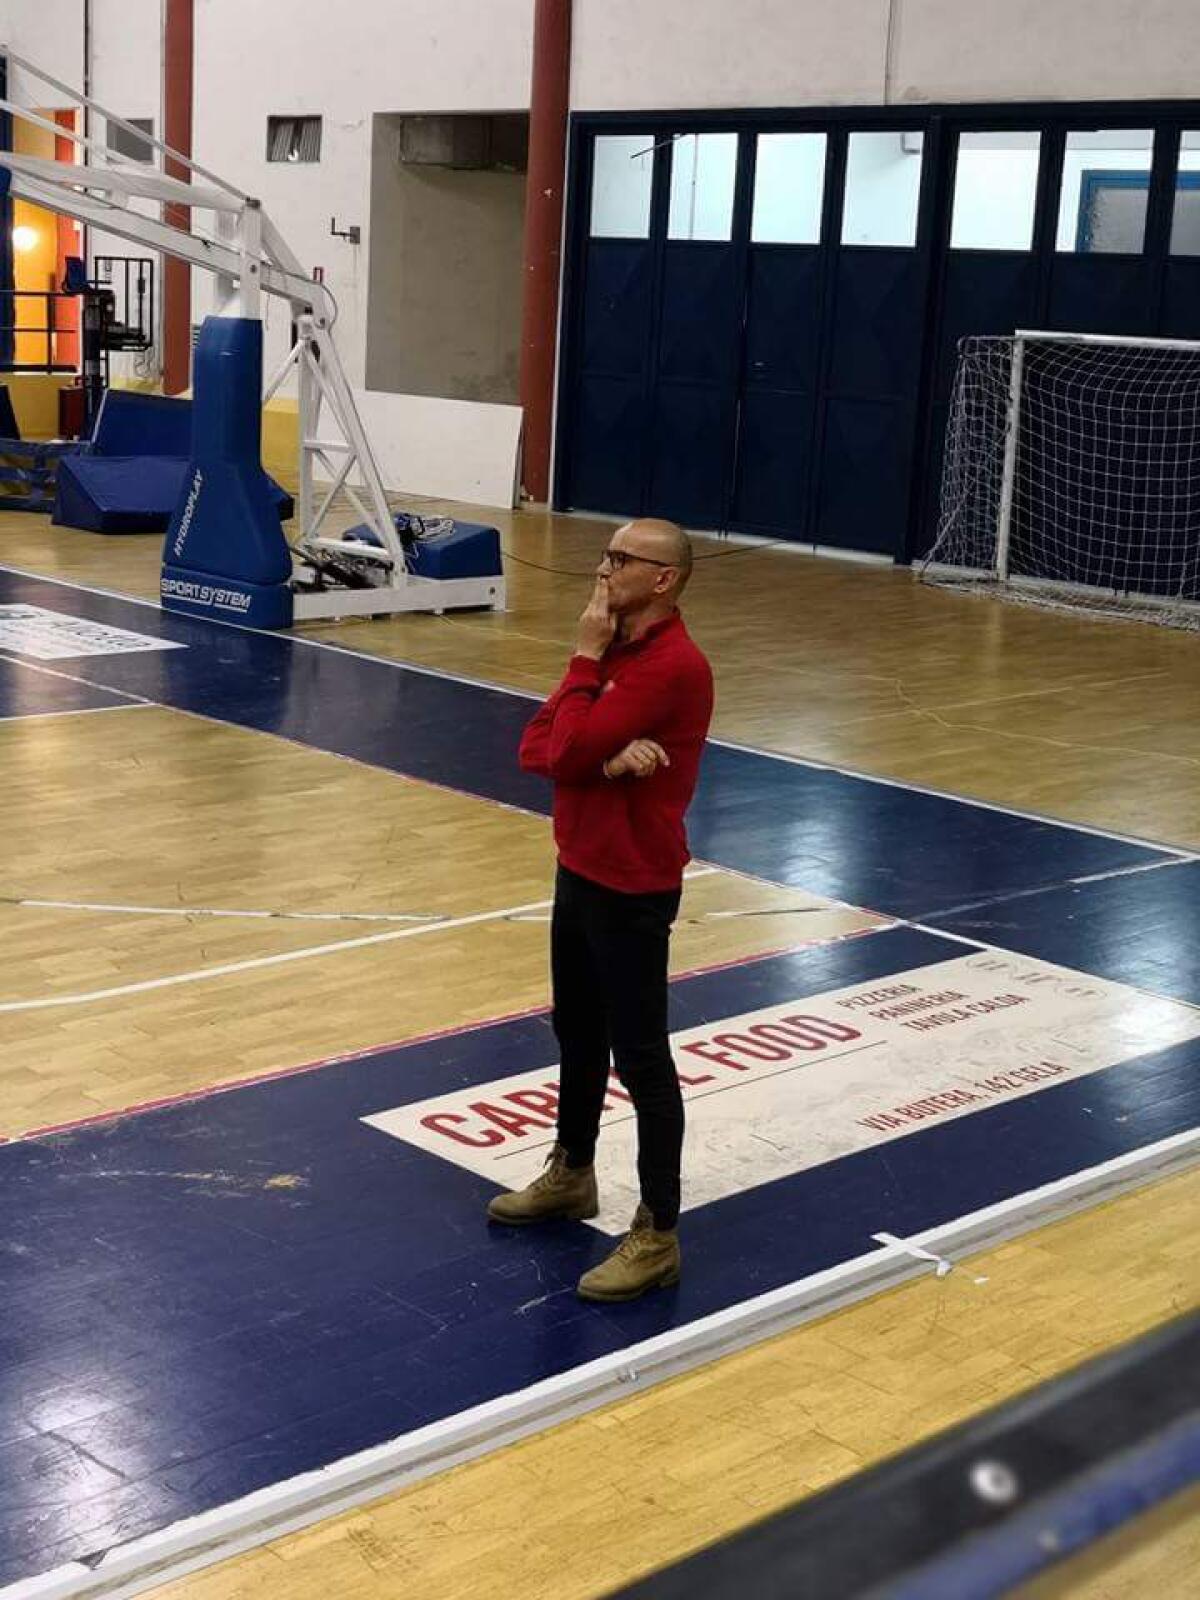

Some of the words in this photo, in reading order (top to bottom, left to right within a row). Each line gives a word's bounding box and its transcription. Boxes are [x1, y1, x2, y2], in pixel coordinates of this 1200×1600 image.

[836, 984, 922, 1010] PIZZERIA
[868, 991, 970, 1020] PANINERIA
[900, 1009, 977, 1031] TAVOLA
[965, 994, 1030, 1014] CALDA
[679, 1015, 862, 1071] FOOD
[856, 1113, 908, 1131] VIA
[1010, 1061, 1070, 1083] GELA
